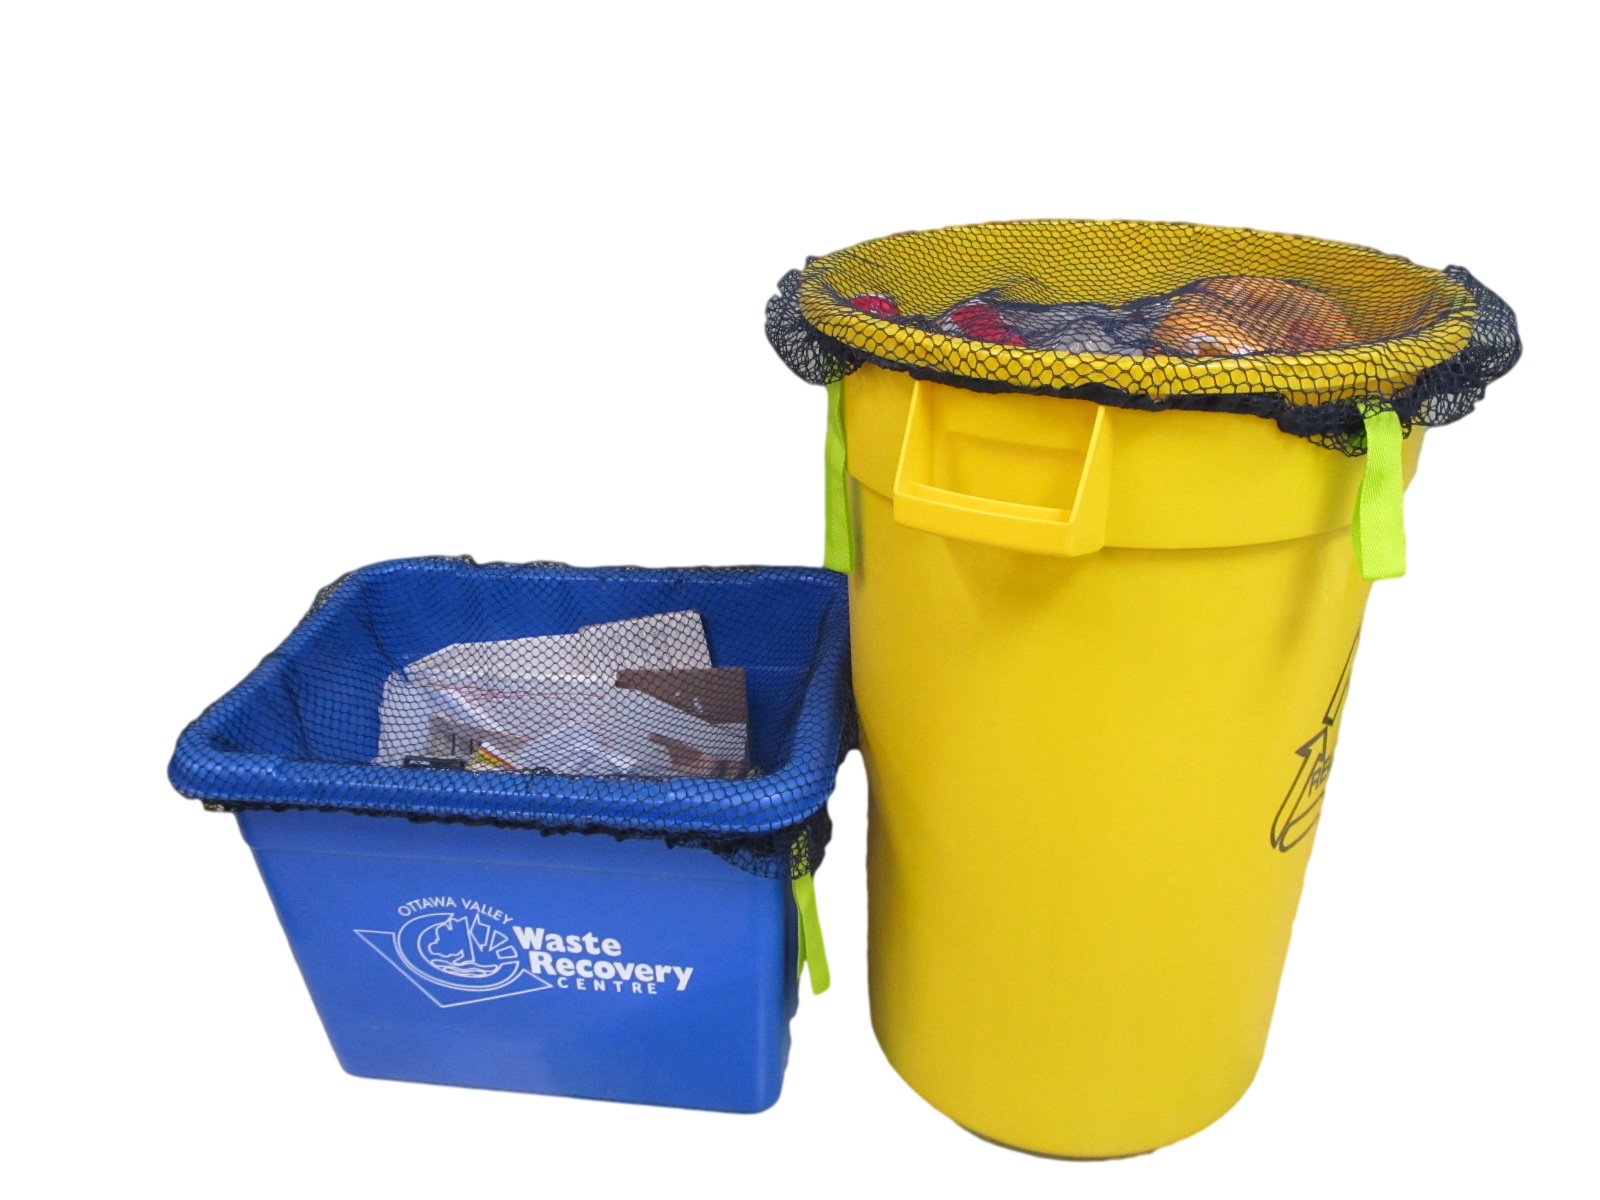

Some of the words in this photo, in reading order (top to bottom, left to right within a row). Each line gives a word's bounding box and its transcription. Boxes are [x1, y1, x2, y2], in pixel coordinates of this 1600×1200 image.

[397, 896, 457, 917] OTTAWA
[460, 898, 514, 925] VALLEY
[512, 926, 622, 957] Waste
[528, 951, 694, 991] Recovery
[556, 976, 658, 994] CENTRE
